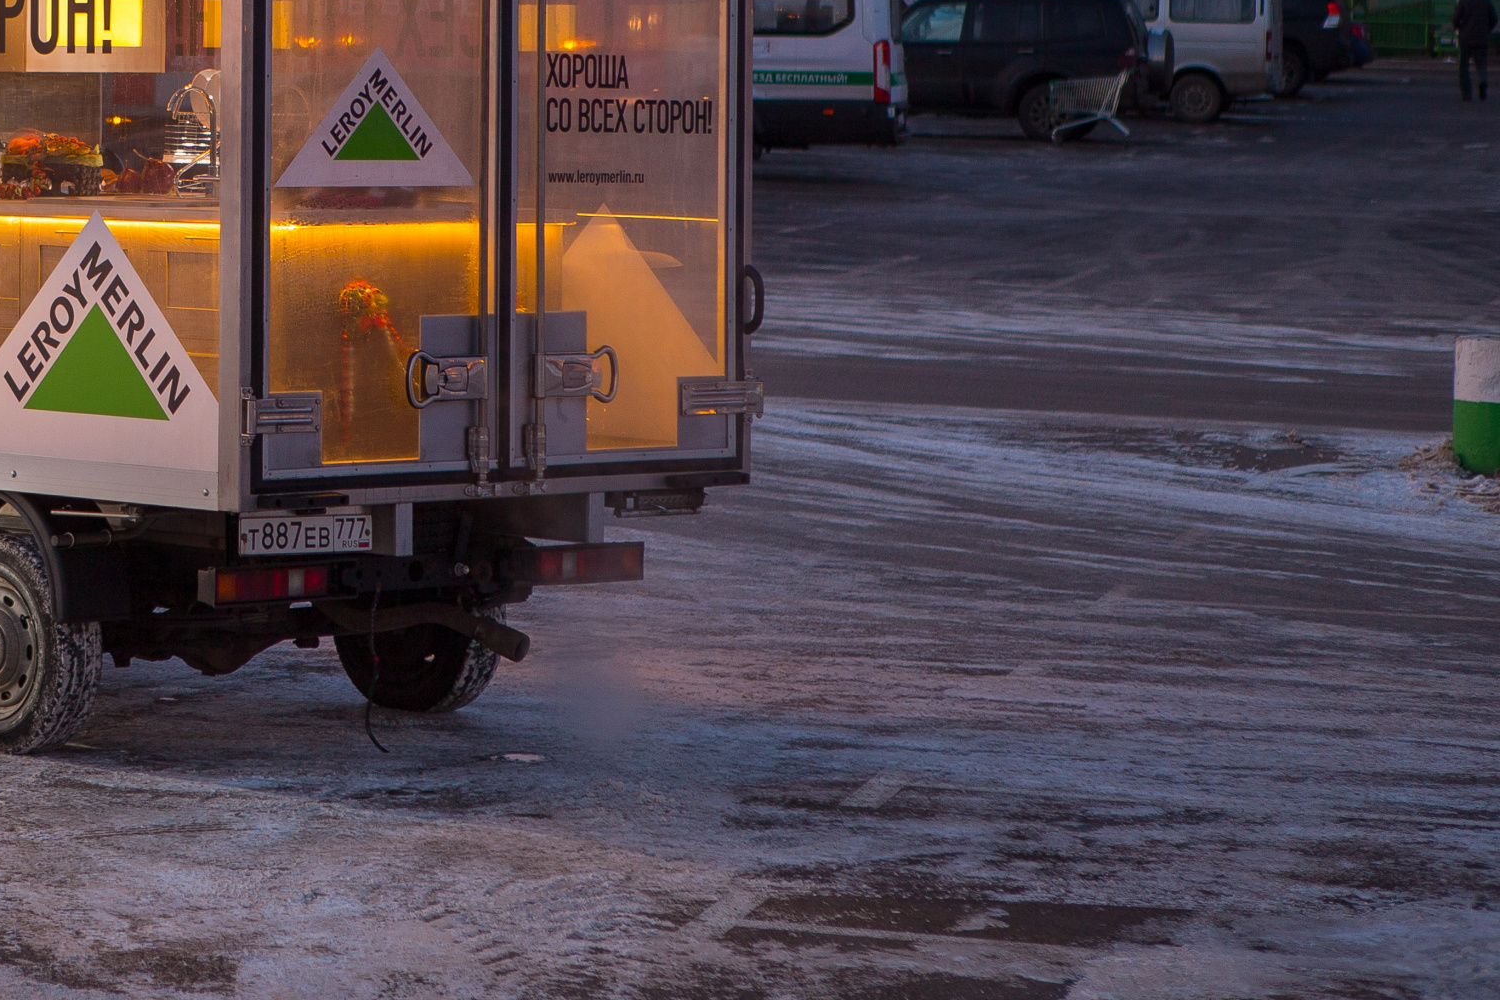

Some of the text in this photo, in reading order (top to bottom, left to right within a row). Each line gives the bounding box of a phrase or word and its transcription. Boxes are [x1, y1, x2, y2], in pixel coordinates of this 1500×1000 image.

[546, 53, 629, 89] ХОРОША
[775, 73, 848, 84] БЕСПЛАТНЫЙ!
[321, 67, 433, 159] LEROY MERLIN
[546, 97, 713, 135] СО ВСЕХ СТОРОН!
[548, 170, 644, 186] www.leroymerlin.ru
[3, 240, 191, 415] LEROY MERLIN
[249, 518, 366, 550] Т887ЕВ 777
[342, 540, 358, 548] RUS
